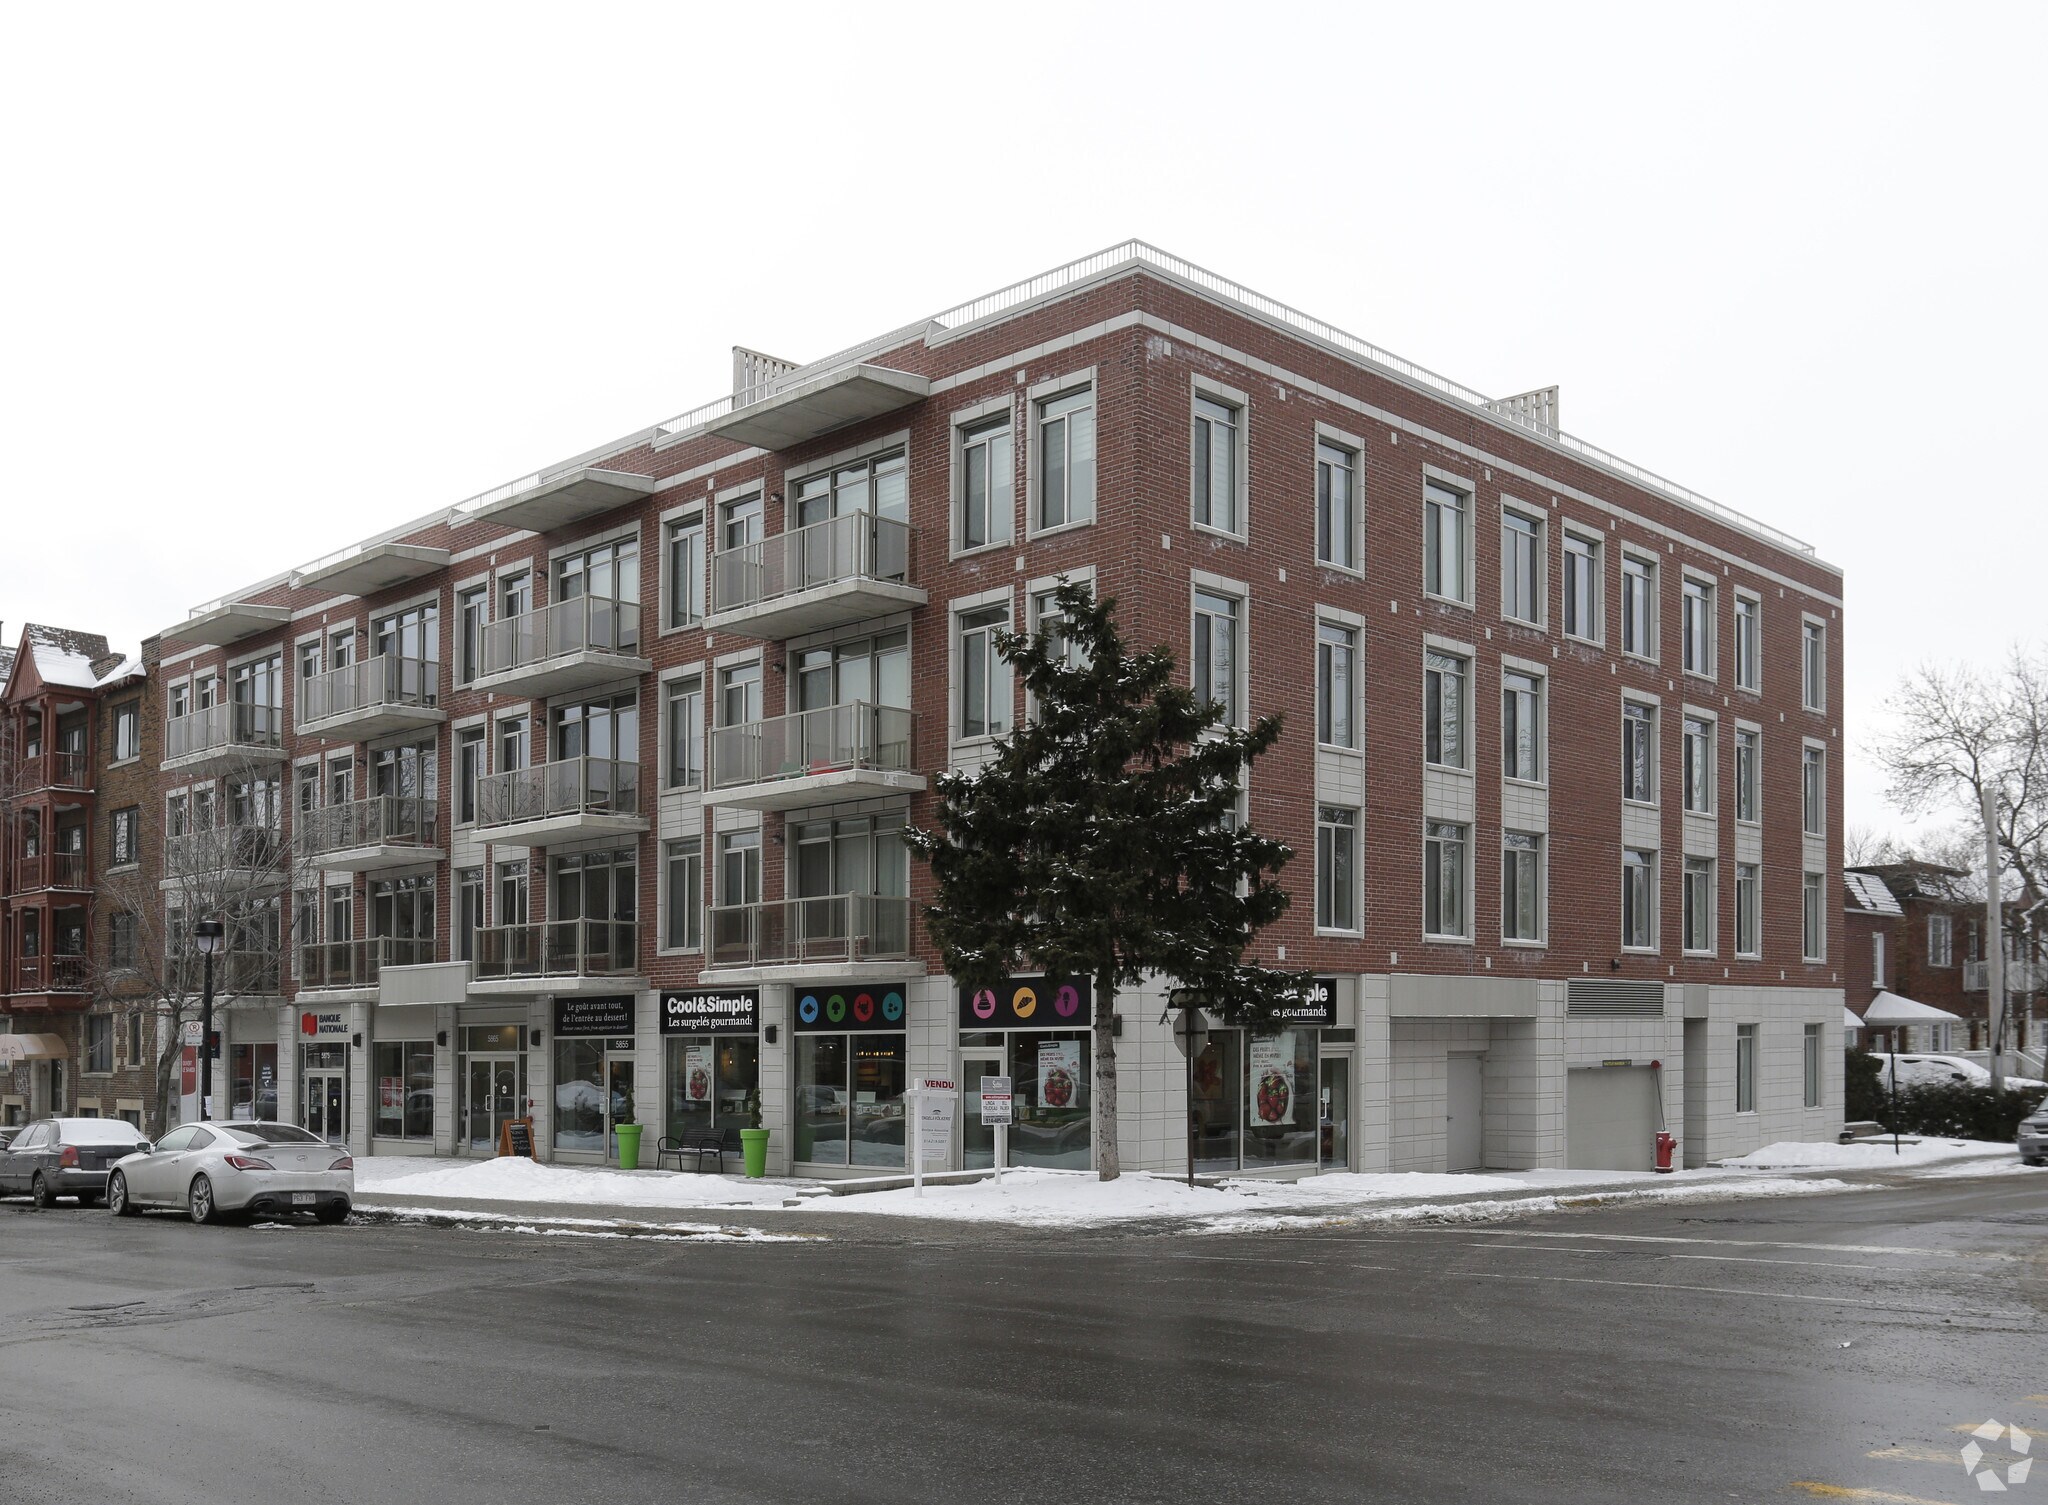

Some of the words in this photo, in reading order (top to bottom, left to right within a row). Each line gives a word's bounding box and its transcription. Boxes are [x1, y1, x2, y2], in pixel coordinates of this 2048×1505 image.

[567, 1003, 574, 1011] Le
[575, 1002, 589, 1014] goût
[608, 1002, 624, 1011] tout,
[667, 995, 753, 1016] Cool&Simple
[319, 1013, 342, 1023] BANQUE
[562, 1014, 570, 1022] de
[571, 1013, 594, 1022] l'entrée
[668, 1017, 680, 1027] Les
[680, 1016, 710, 1030] surgelés
[319, 1024, 349, 1034] NATIONALE
[487, 1034, 500, 1043] 5865
[615, 1040, 629, 1049] 5855
[925, 1079, 955, 1089] VENDU
